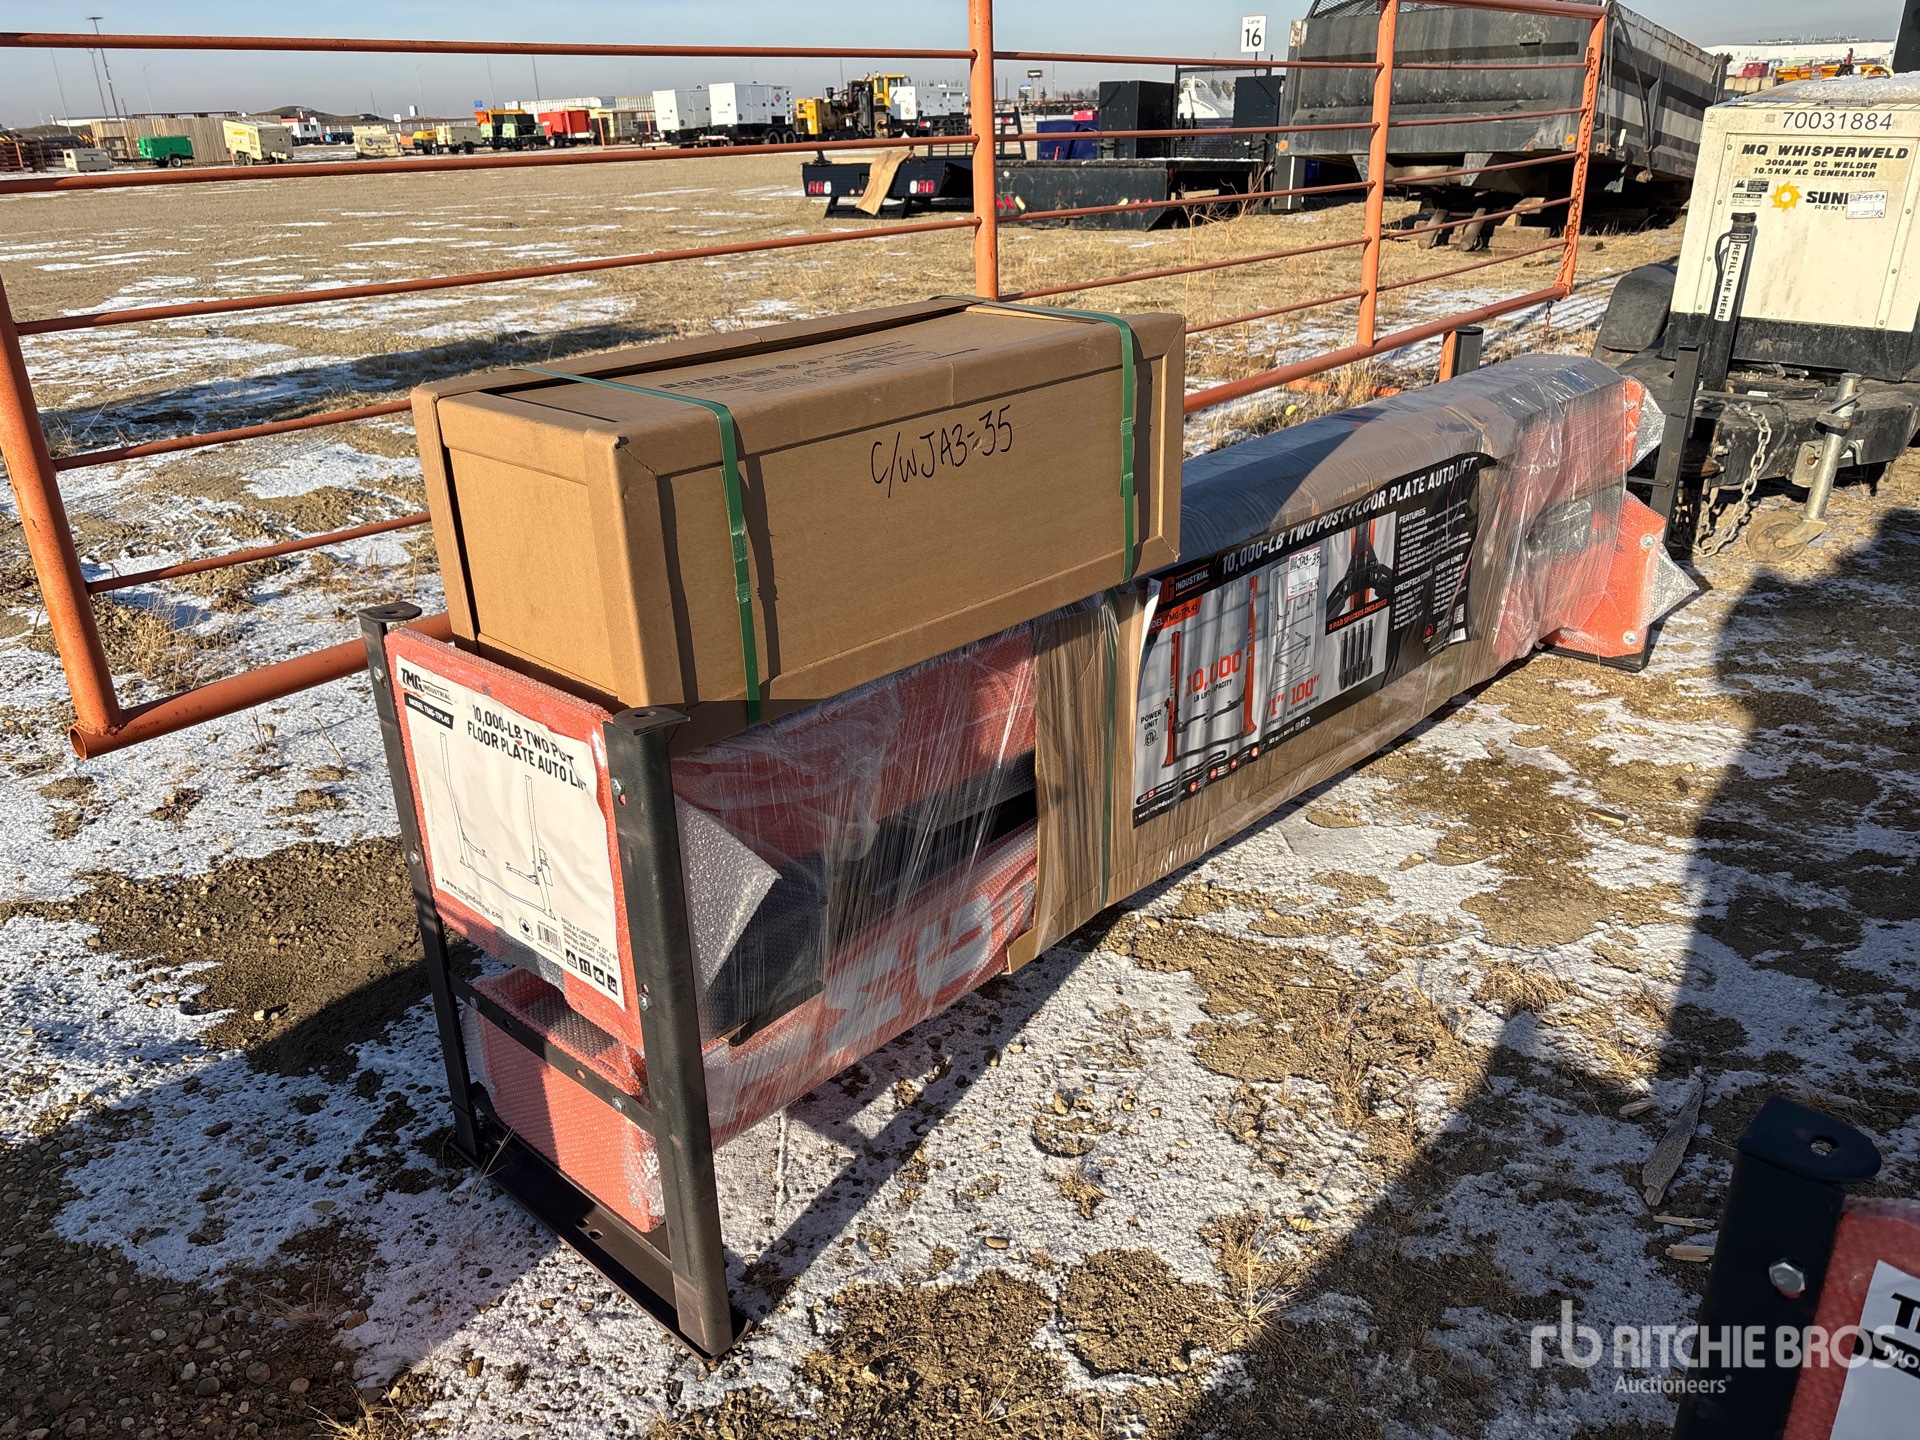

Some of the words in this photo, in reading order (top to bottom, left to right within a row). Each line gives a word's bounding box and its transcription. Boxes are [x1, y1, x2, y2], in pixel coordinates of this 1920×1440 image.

[1245, 27, 1262, 47] 16
[1782, 112, 1892, 130] 70031884
[1742, 144, 1768, 156] MQ
[1778, 144, 1909, 159] WHISPERWELD
[1765, 159, 1808, 167] 300AMP
[1834, 161, 1878, 169] WELDER
[1813, 169, 1876, 178] GENERATOR
[1806, 191, 1848, 205] SUN
[1727, 243, 1741, 276] REFILL
[1724, 279, 1733, 294] ME
[1717, 295, 1728, 320] HERE
[1222, 531, 1286, 574] 10,000-LB
[1288, 520, 1316, 545] TWO
[1316, 506, 1350, 533] POST
[1349, 490, 1386, 519] FLOOR
[1389, 475, 1426, 504] PLATE
[1428, 464, 1454, 490] AUTO
[1455, 456, 1478, 478] LIFT
[1399, 507, 1426, 524] FEATURES
[1435, 558, 1450, 572] POWER
[1450, 553, 1464, 565] UNIT
[1176, 570, 1209, 591] INDUSTRIAL
[1394, 568, 1433, 594] SPECIFICATIONS
[1333, 619, 1344, 629] PAD
[1344, 609, 1364, 624] SPACERS
[1364, 598, 1388, 613] INCLUDED
[1186, 649, 1242, 698] 10,000
[401, 667, 424, 692] TMG
[423, 684, 451, 701] INDUSTRIAL
[1291, 674, 1320, 705] 100"
[408, 697, 424, 711] MODEL
[1140, 709, 1161, 724] POWER
[1144, 718, 1158, 730] UNIT
[467, 720, 499, 749] FLOOR
[501, 736, 535, 767] PLATE
[538, 754, 566, 782] AUTO
[524, 728, 549, 754] TWO
